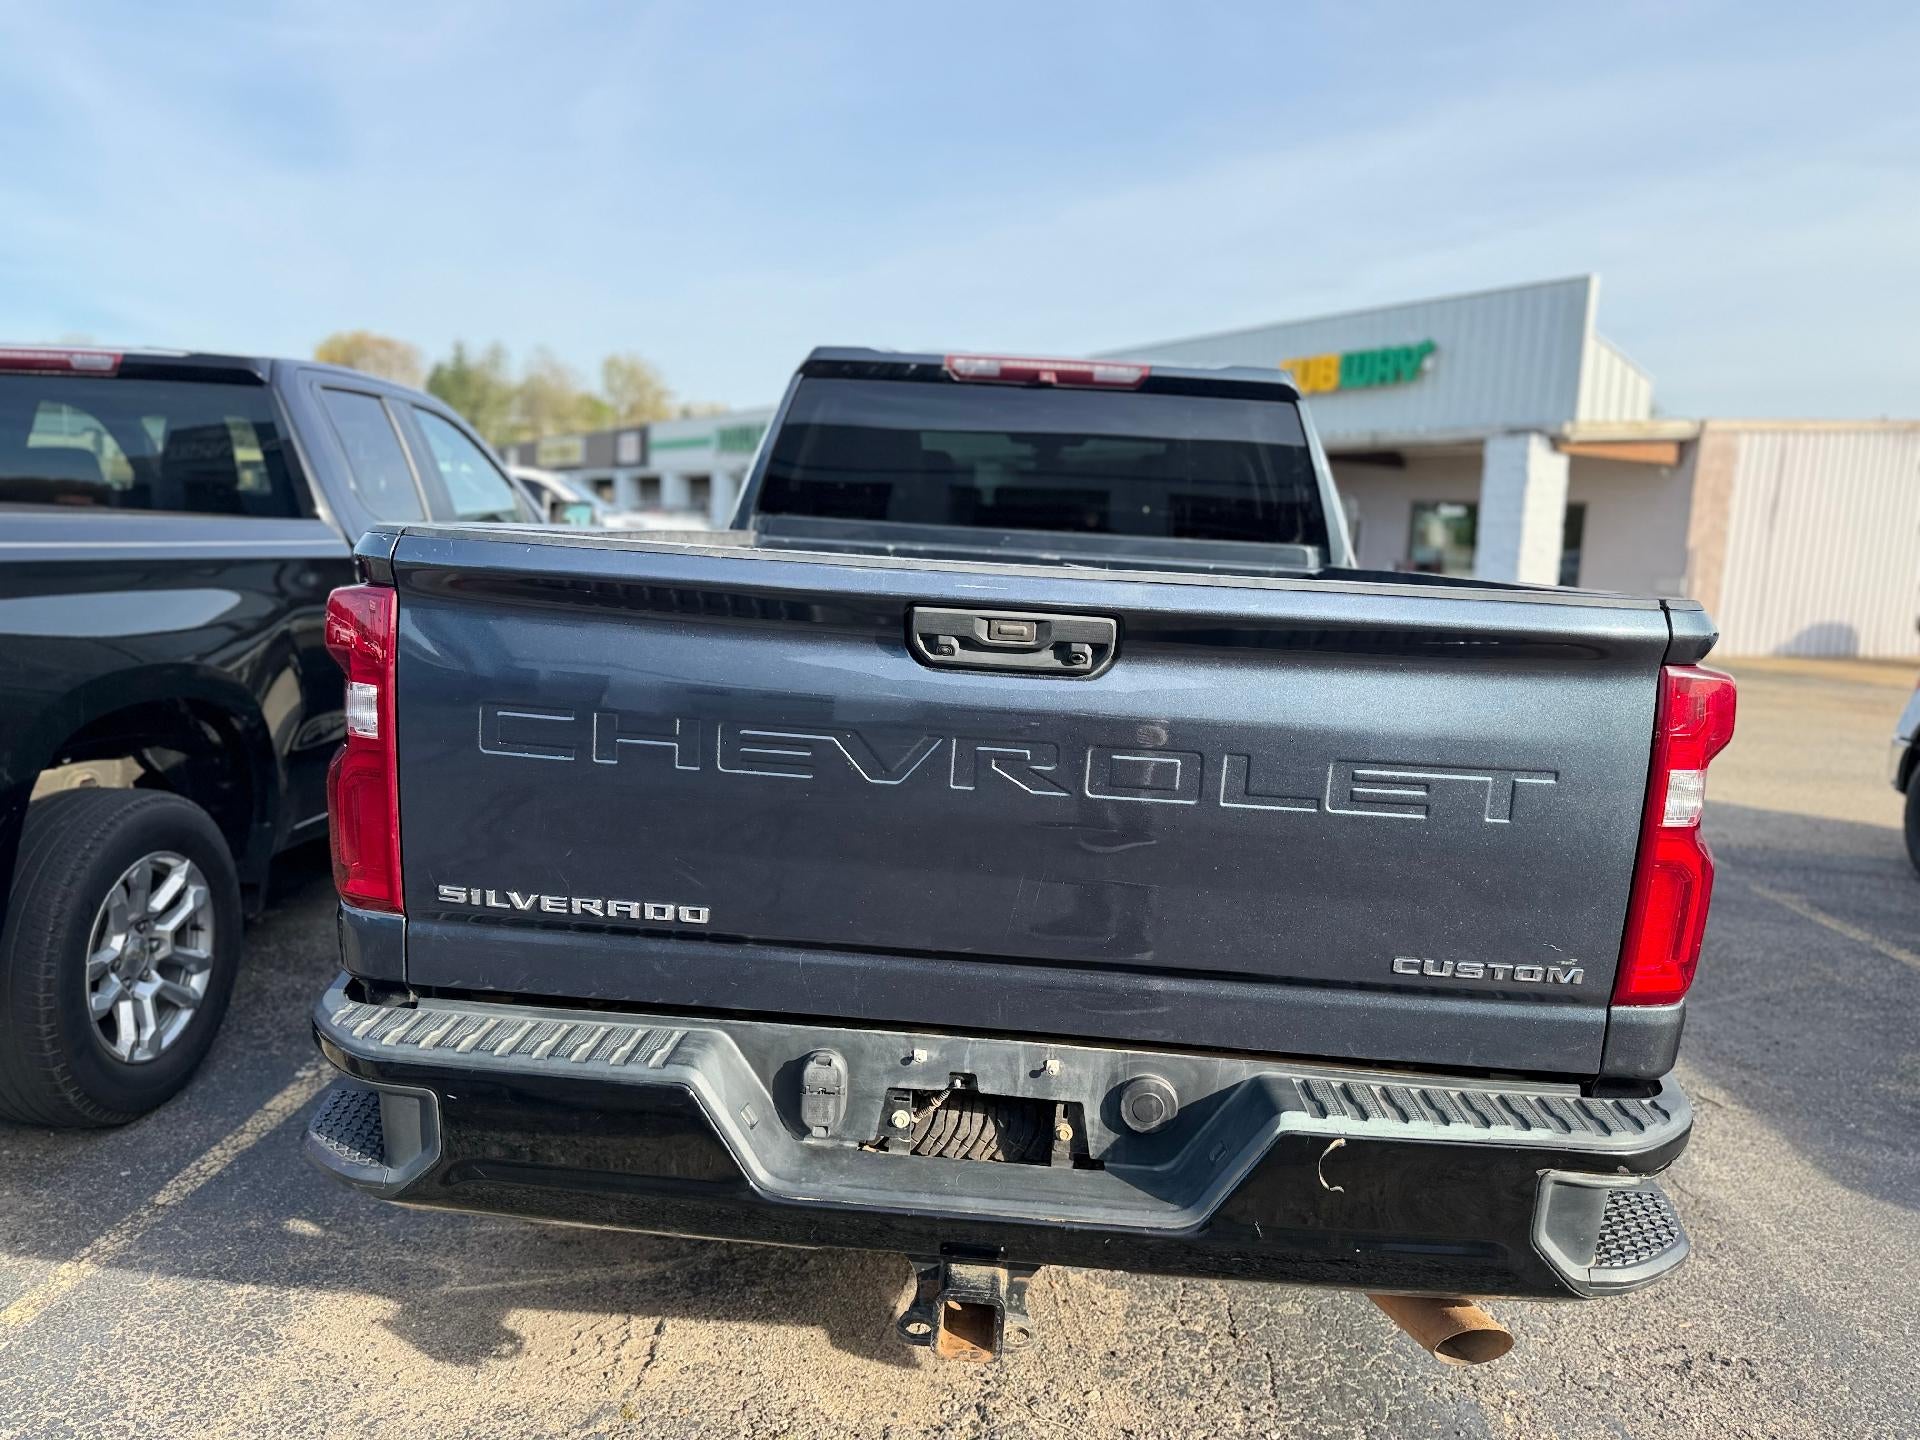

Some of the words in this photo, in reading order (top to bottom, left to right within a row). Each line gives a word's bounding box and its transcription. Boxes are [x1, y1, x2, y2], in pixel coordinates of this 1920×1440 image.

[477, 701, 1560, 824] CHEVROLET
[437, 884, 711, 924] SILVERADO
[1392, 957, 1585, 985] CUSTOM
